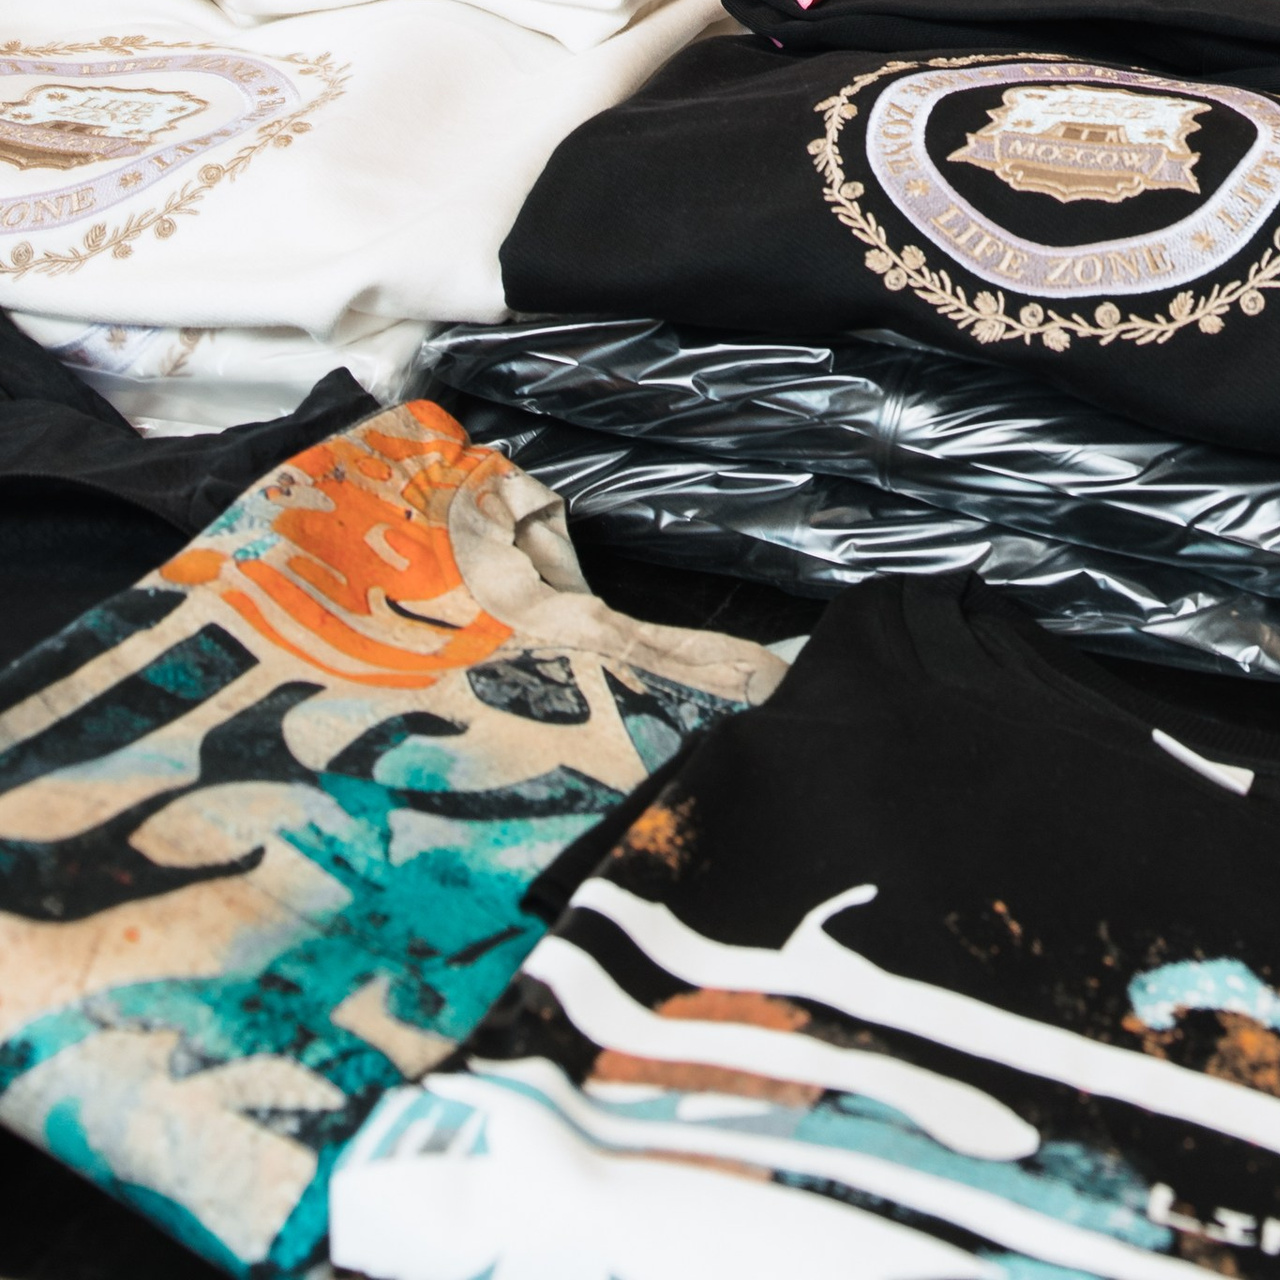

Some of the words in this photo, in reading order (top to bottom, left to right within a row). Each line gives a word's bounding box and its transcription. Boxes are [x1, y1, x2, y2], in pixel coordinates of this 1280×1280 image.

[1008, 139, 1152, 169] MOSCOW
[0, 187, 97, 227] ONE
[930, 203, 1031, 280] LIFE
[1045, 243, 1177, 286] ZONE
